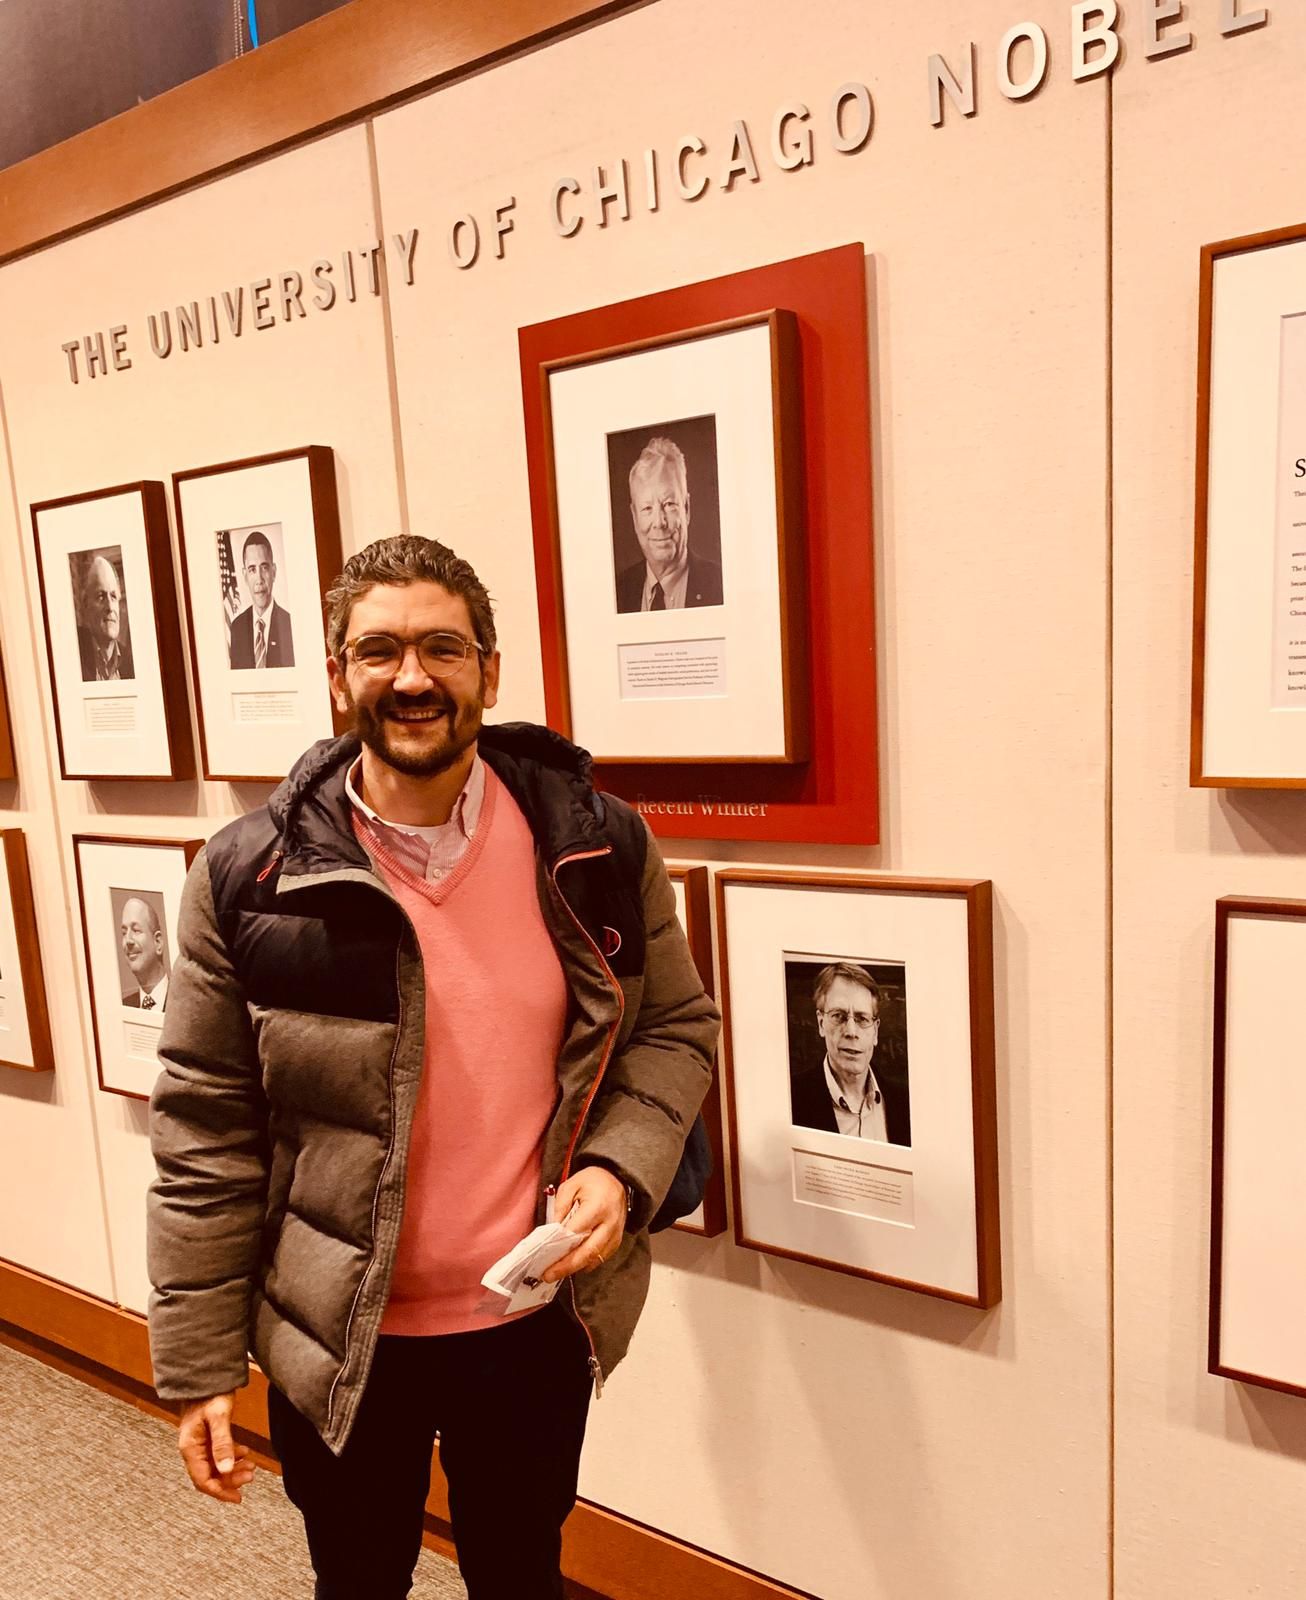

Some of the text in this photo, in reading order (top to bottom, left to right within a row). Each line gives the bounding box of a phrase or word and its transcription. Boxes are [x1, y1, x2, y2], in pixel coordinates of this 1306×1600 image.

[61, 325, 133, 384] THE
[147, 228, 419, 359] UNIVERSITY
[449, 196, 517, 269] OF
[550, 81, 876, 238] CHICAGO
[637, 793, 769, 817] Recent Winner
